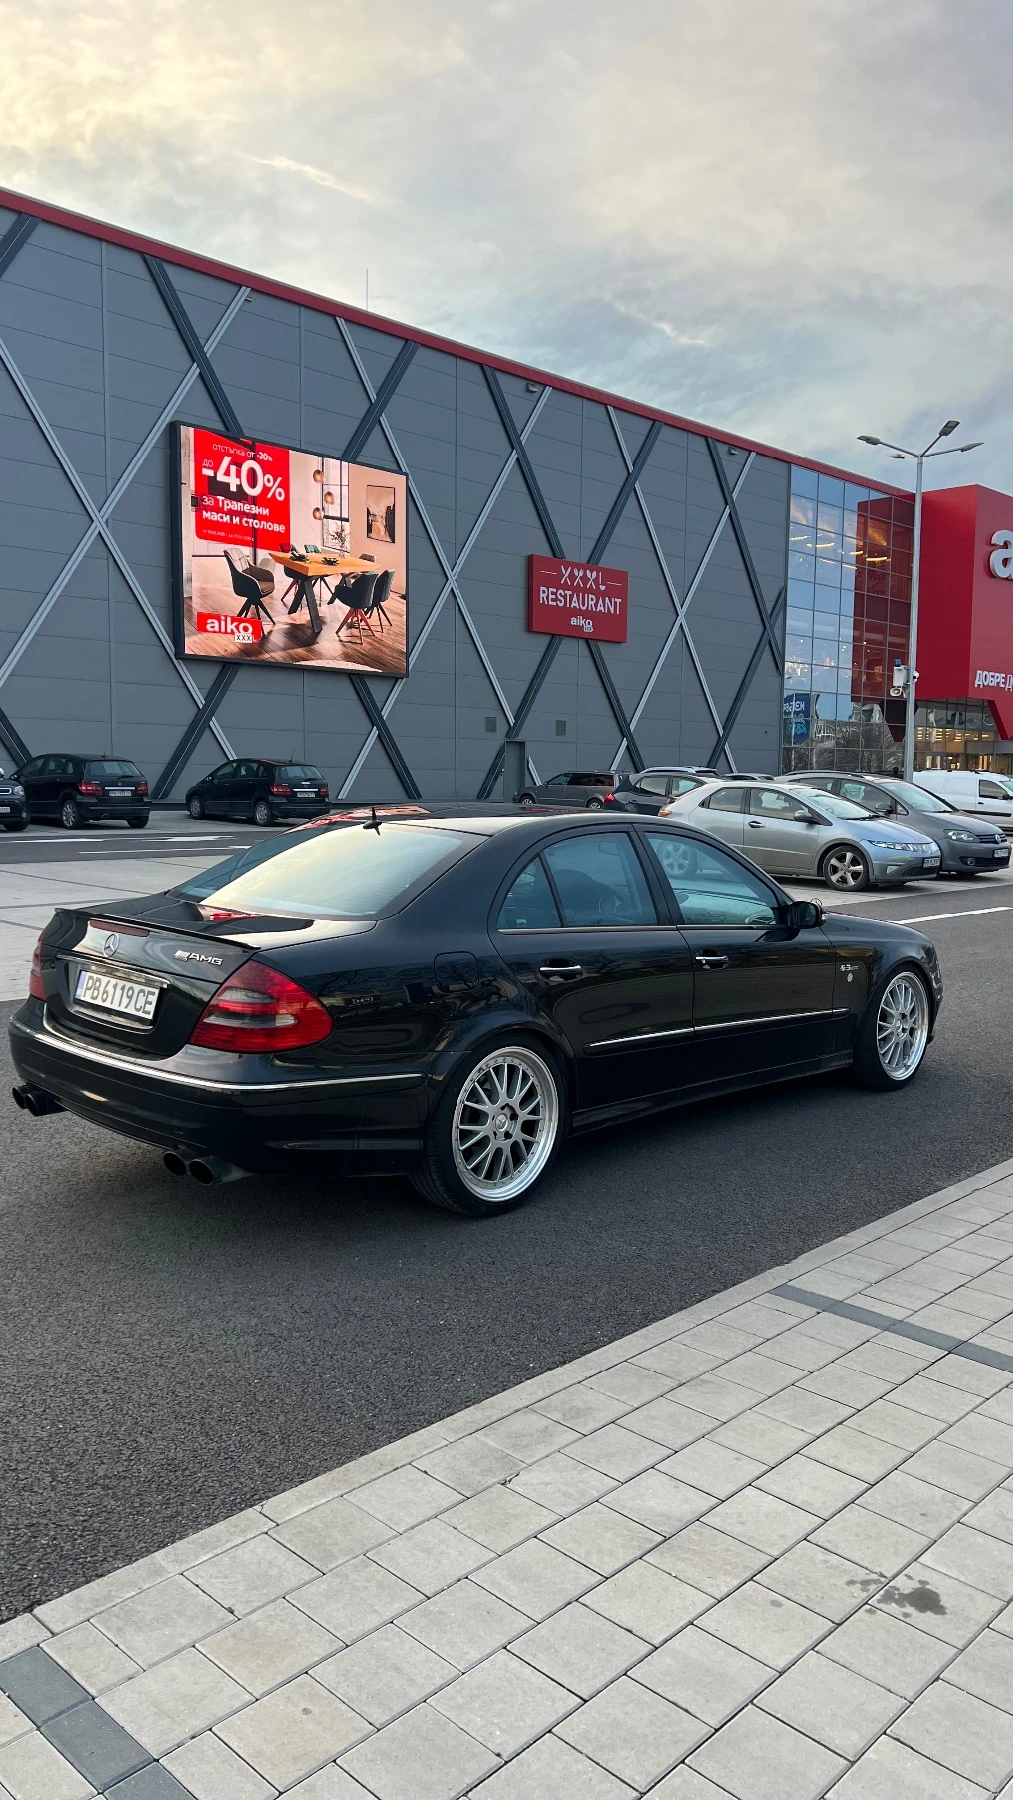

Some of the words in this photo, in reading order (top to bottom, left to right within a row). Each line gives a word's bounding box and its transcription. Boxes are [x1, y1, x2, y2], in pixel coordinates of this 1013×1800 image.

[202, 456, 285, 501] -40%
[217, 496, 269, 516] Трапезни
[202, 510, 230, 523] маси
[232, 515, 240, 525] и
[242, 516, 286, 533] столове
[539, 586, 622, 615] RESTAURANT
[206, 616, 253, 634] aiko
[570, 616, 593, 628] aiko
[974, 669, 1005, 689] ДОБРЕ
[1005, 674, 1013, 692] Д
[188, 952, 223, 966] AMG
[82, 975, 156, 1015] PB6119CE
